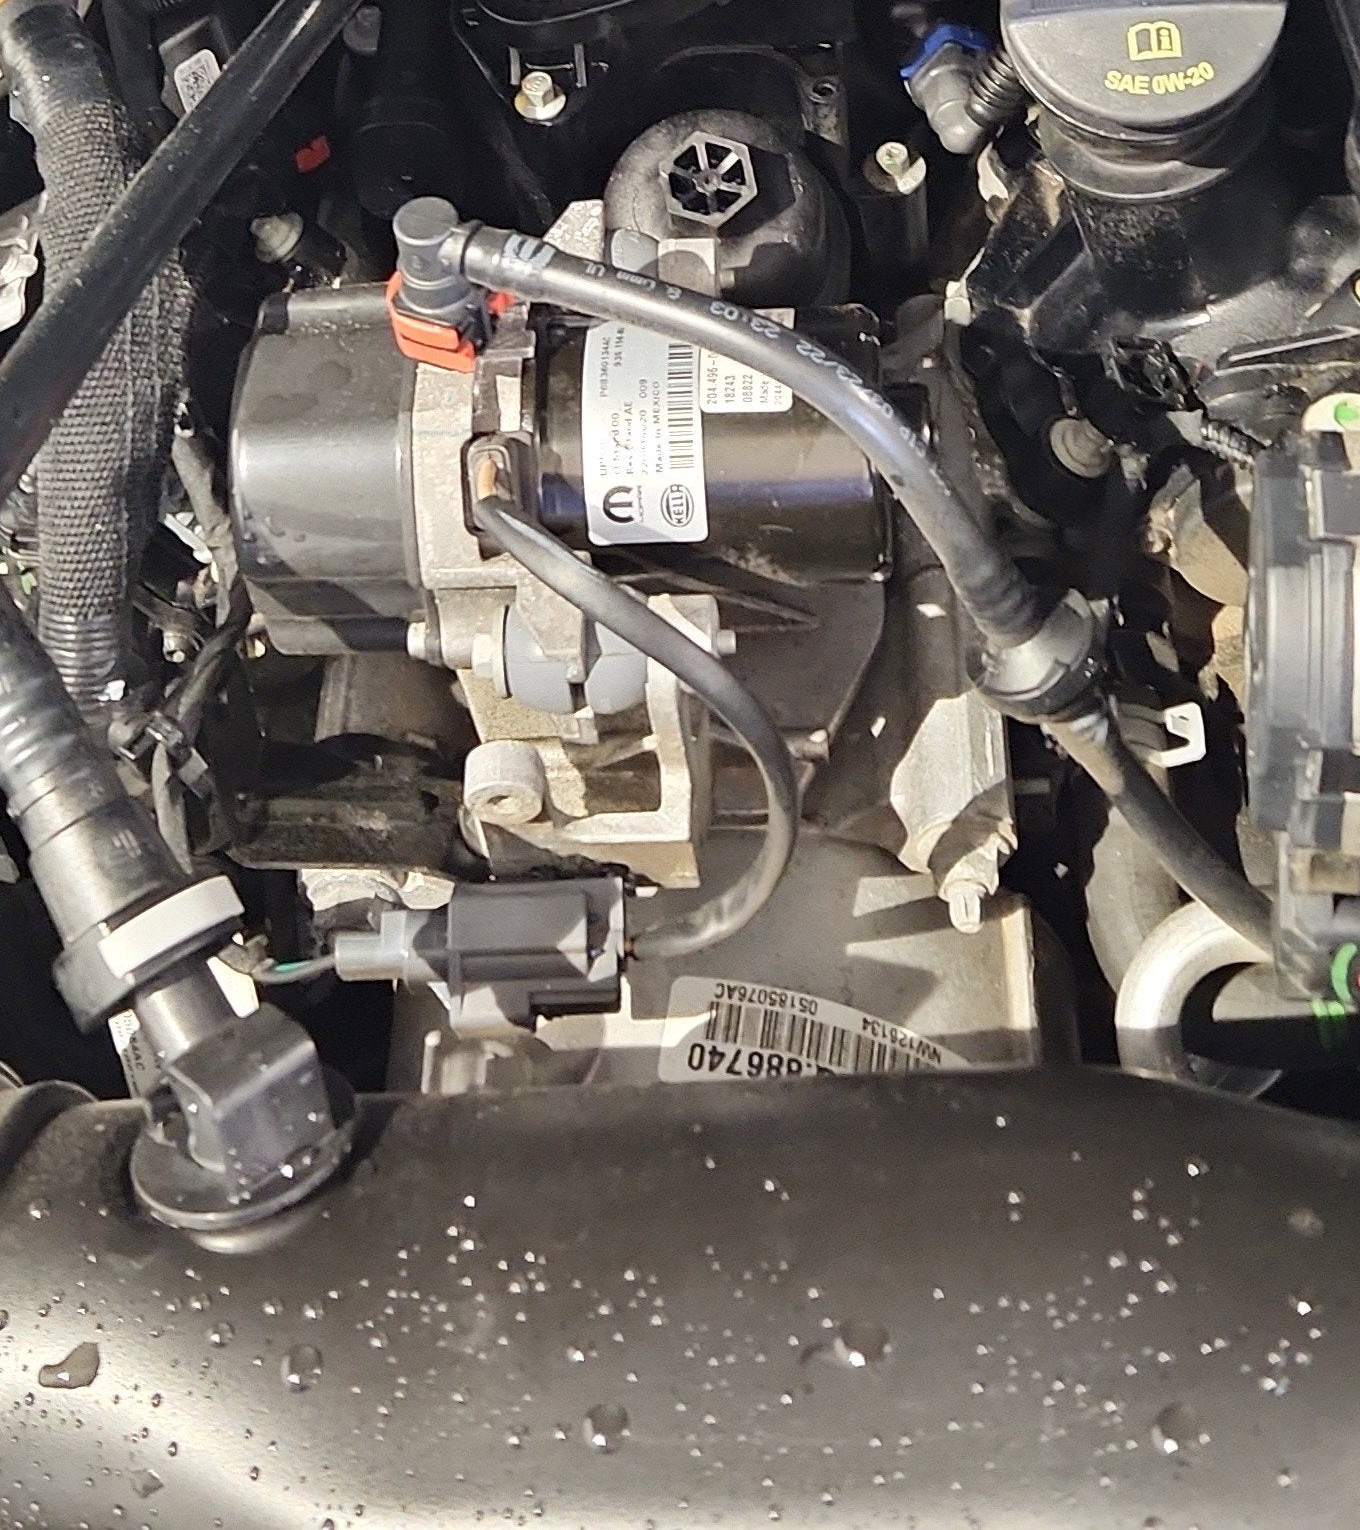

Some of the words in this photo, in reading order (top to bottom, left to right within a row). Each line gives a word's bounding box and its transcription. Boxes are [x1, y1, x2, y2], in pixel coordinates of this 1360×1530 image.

[1105, 70, 1150, 95] SAE
[1152, 61, 1214, 94] 0W-20
[652, 380, 660, 425] MEXICO
[668, 483, 684, 525] HELLA
